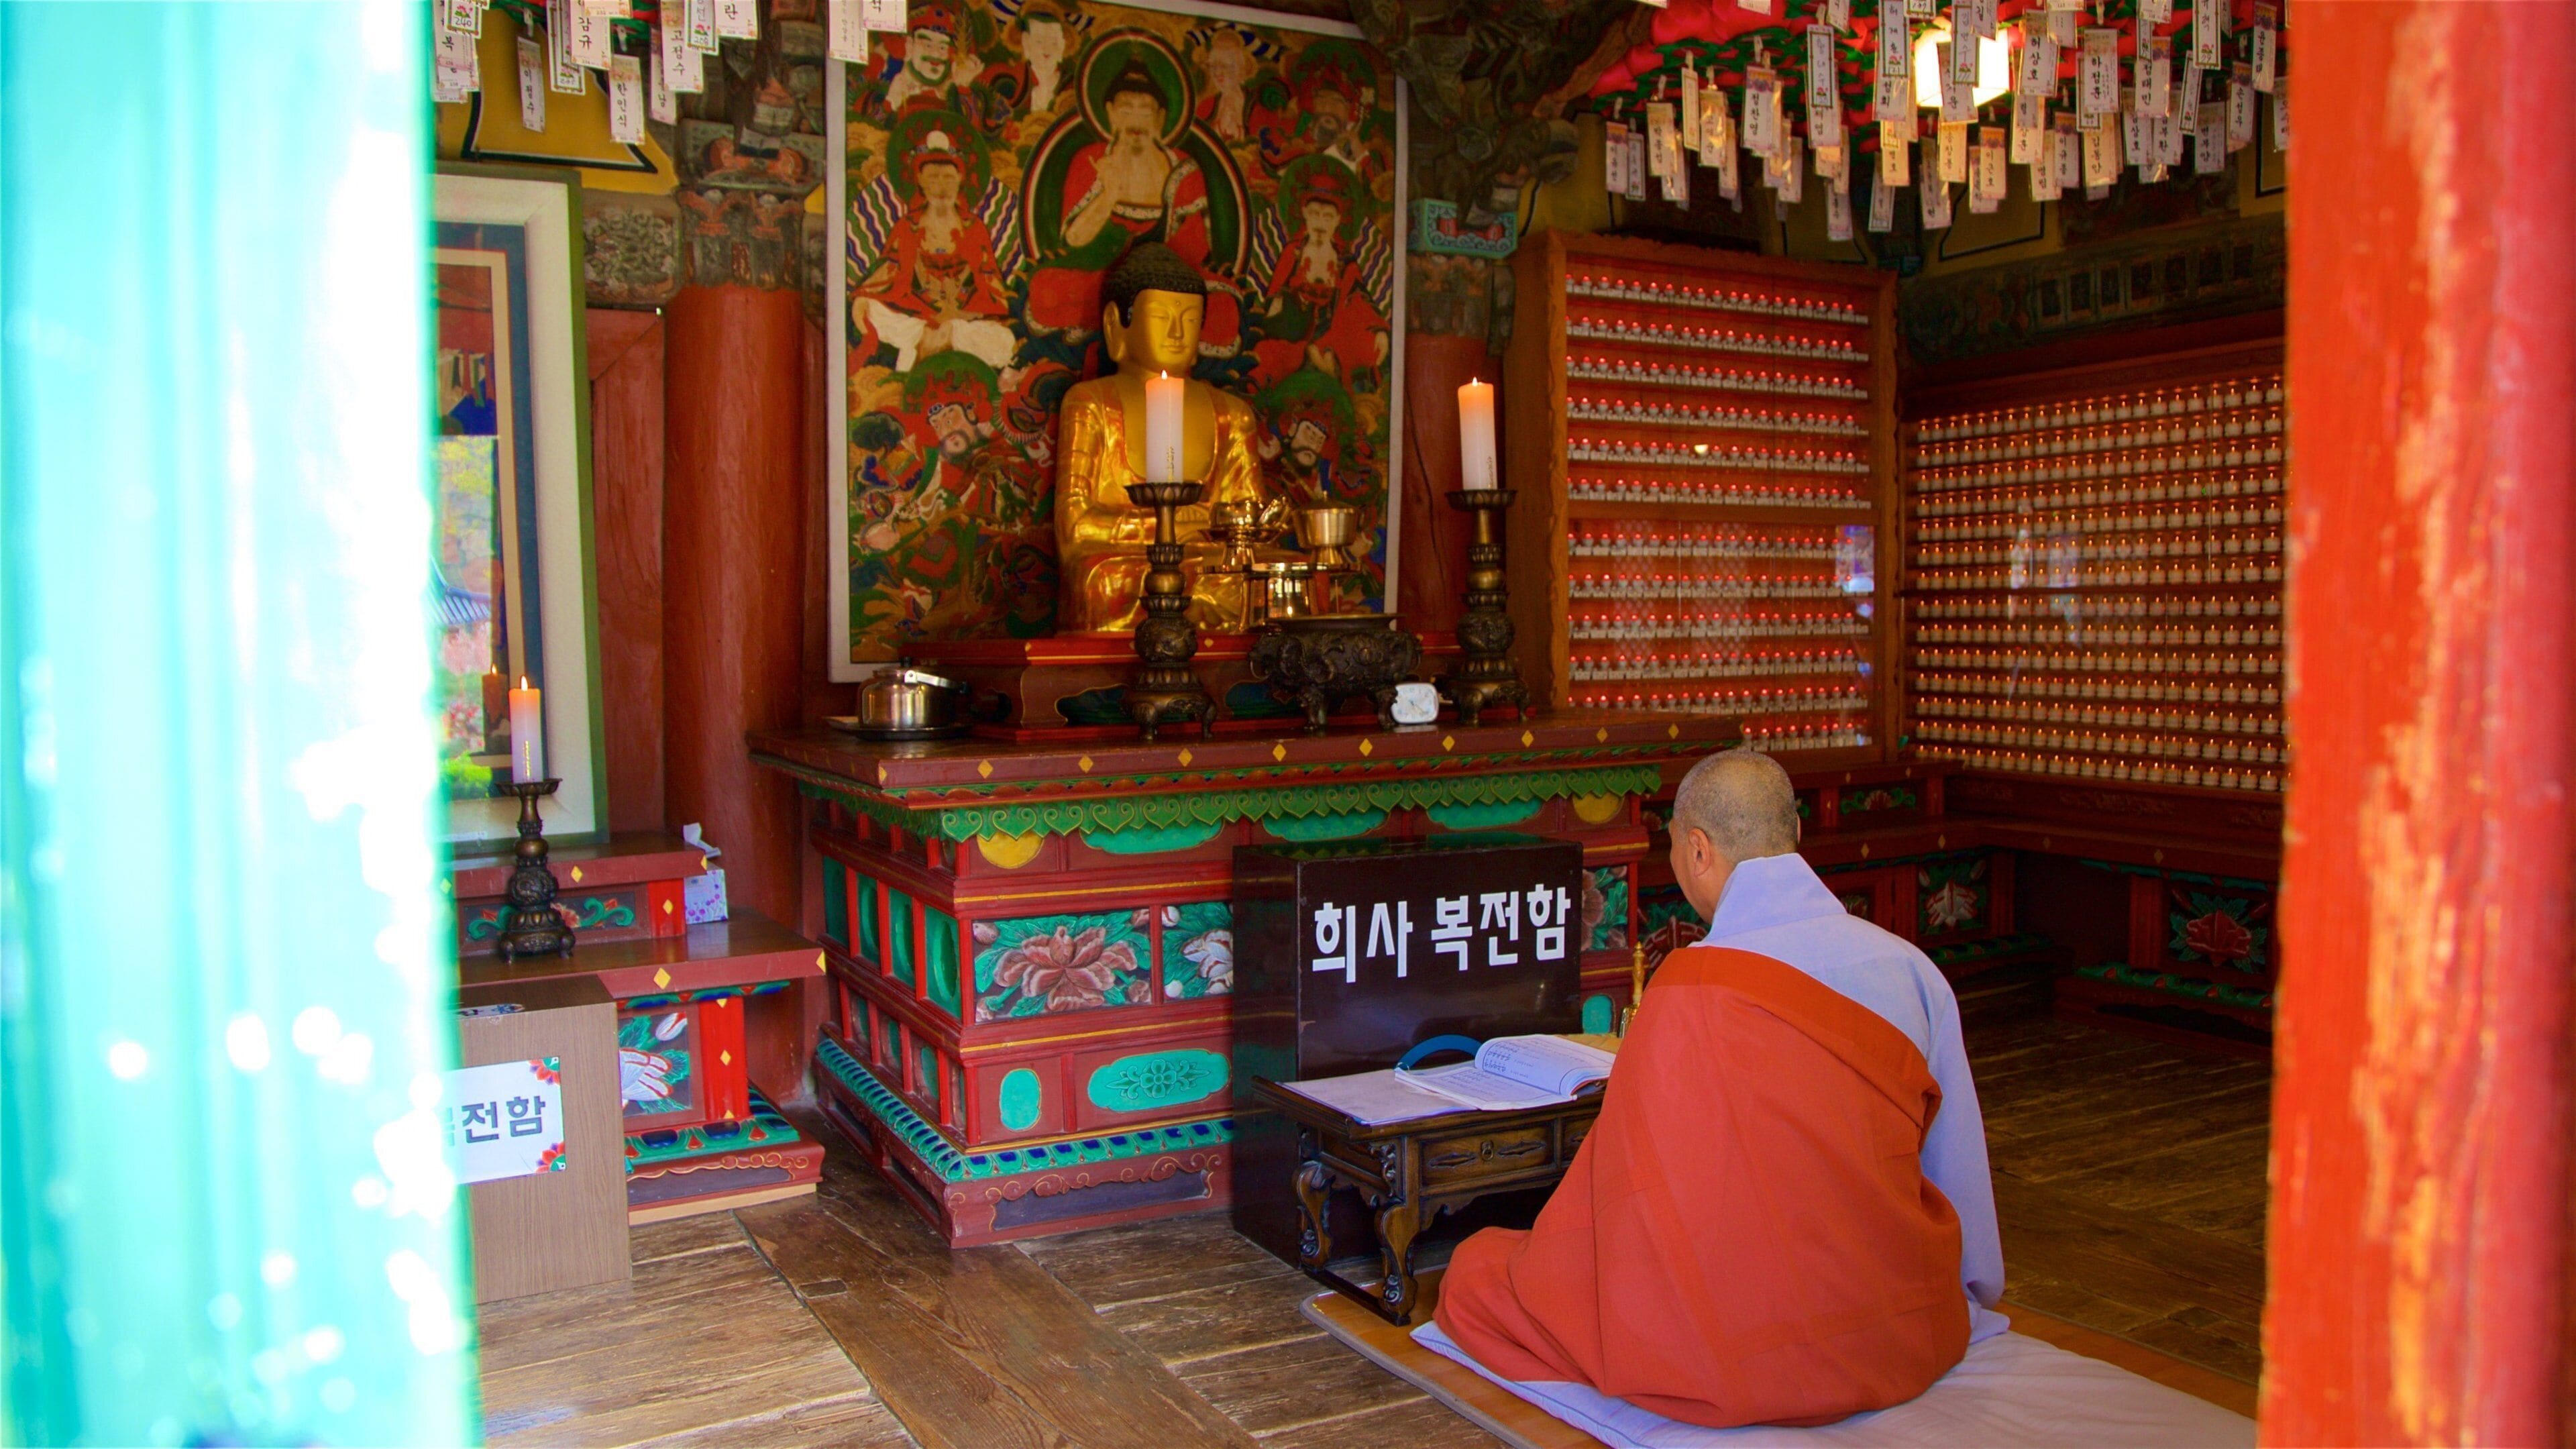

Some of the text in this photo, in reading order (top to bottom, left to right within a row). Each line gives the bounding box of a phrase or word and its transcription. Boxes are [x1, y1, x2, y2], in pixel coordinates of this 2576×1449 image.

[454, 17, 472, 28] 240
[2027, 36, 2041, 80] 허상호
[1312, 883, 1571, 983] 희사 복전함
